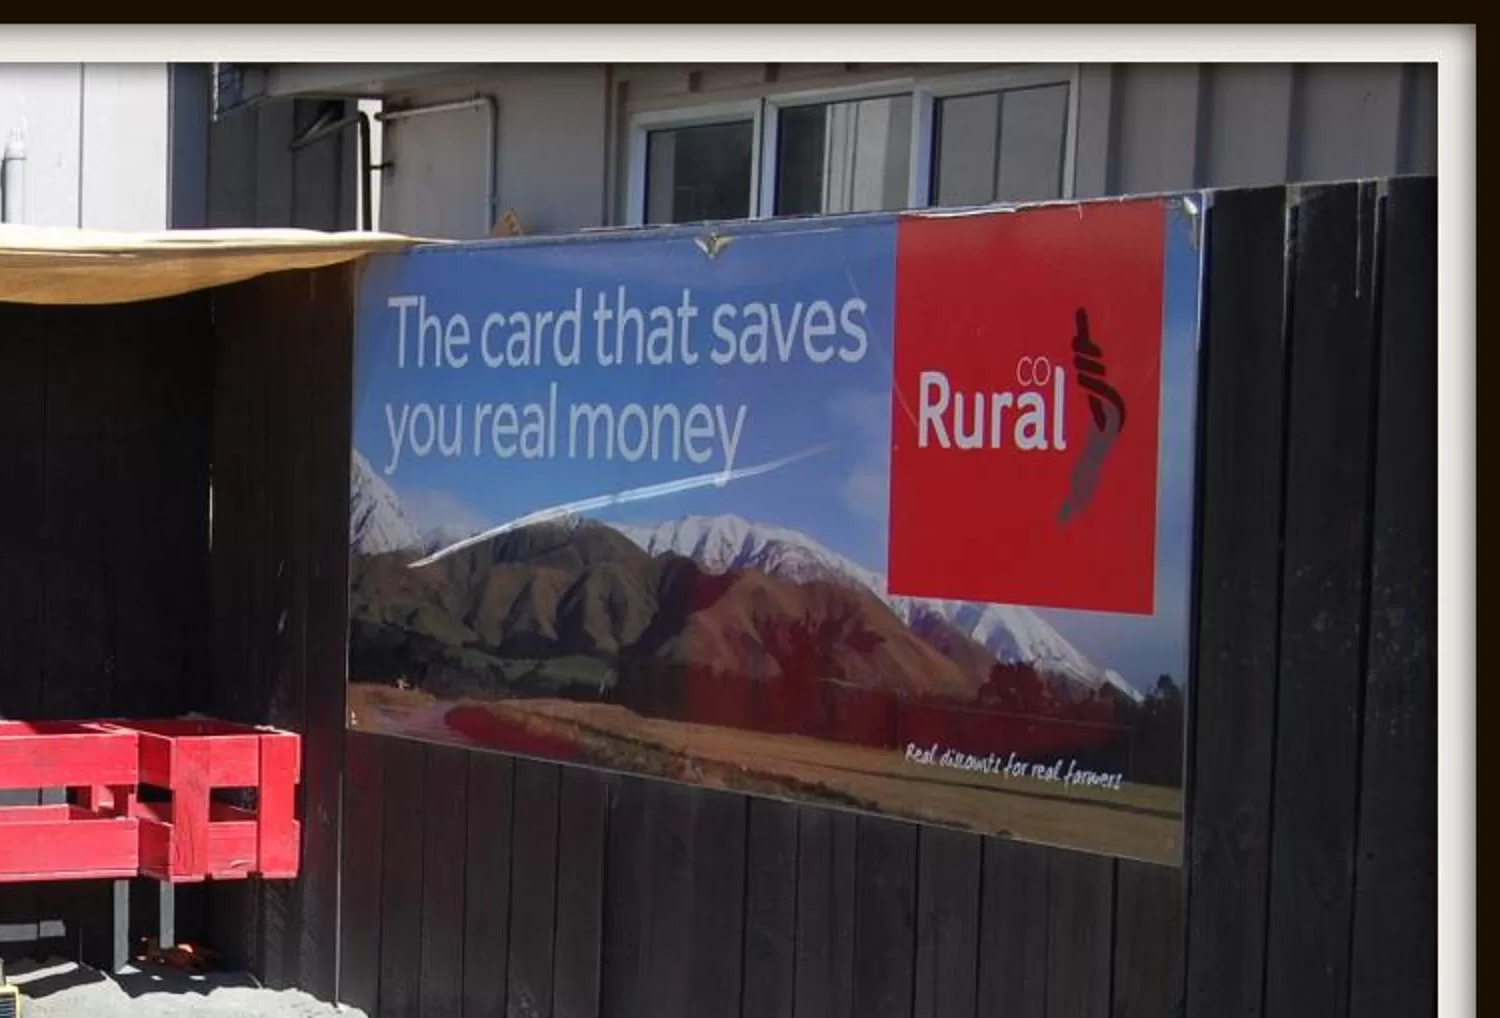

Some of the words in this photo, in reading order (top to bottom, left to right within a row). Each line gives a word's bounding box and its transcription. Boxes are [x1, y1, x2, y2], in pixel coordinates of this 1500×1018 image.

[388, 296, 470, 368] The
[481, 287, 583, 368] card
[593, 285, 698, 366] that
[710, 296, 868, 364] saves
[385, 402, 464, 474] you
[474, 382, 556, 462] real
[569, 401, 747, 485] money
[917, 366, 1066, 451] Rural
[905, 742, 938, 766] Real
[939, 749, 1002, 775] discounts
[1003, 752, 1027, 778] for
[1031, 760, 1063, 782] real
[1063, 760, 1125, 791] farmers
